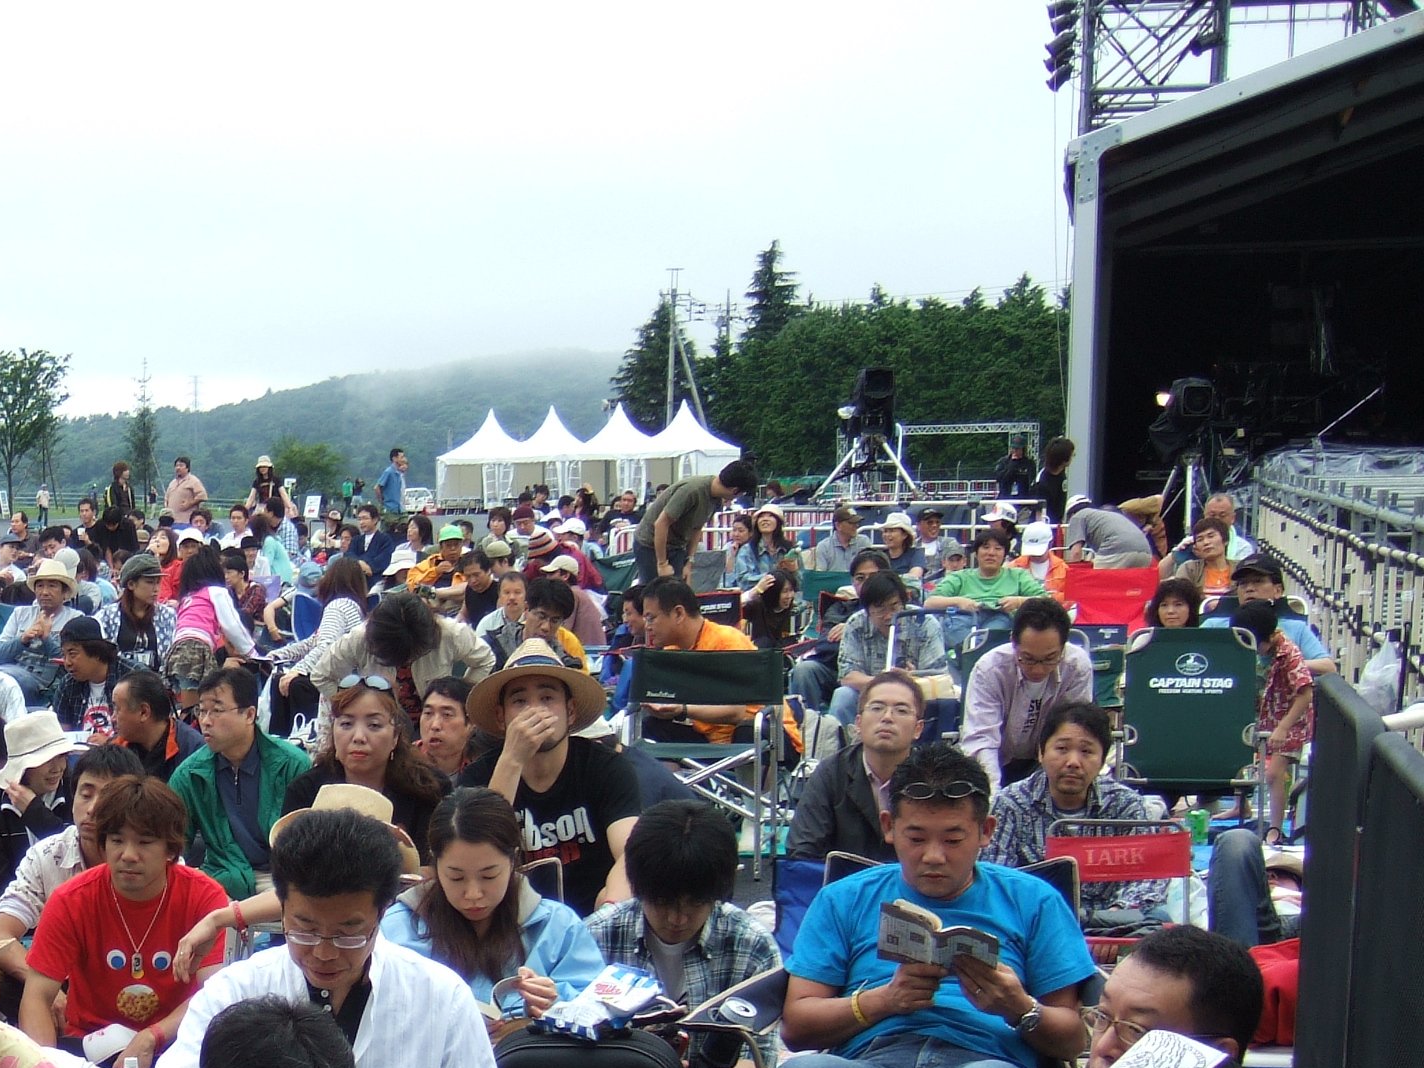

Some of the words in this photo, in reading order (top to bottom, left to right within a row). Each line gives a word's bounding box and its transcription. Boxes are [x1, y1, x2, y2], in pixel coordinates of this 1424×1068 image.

[1149, 677, 1202, 689] CAPTAIN
[1202, 677, 1234, 689] STAG
[1084, 847, 1145, 867] LARK
